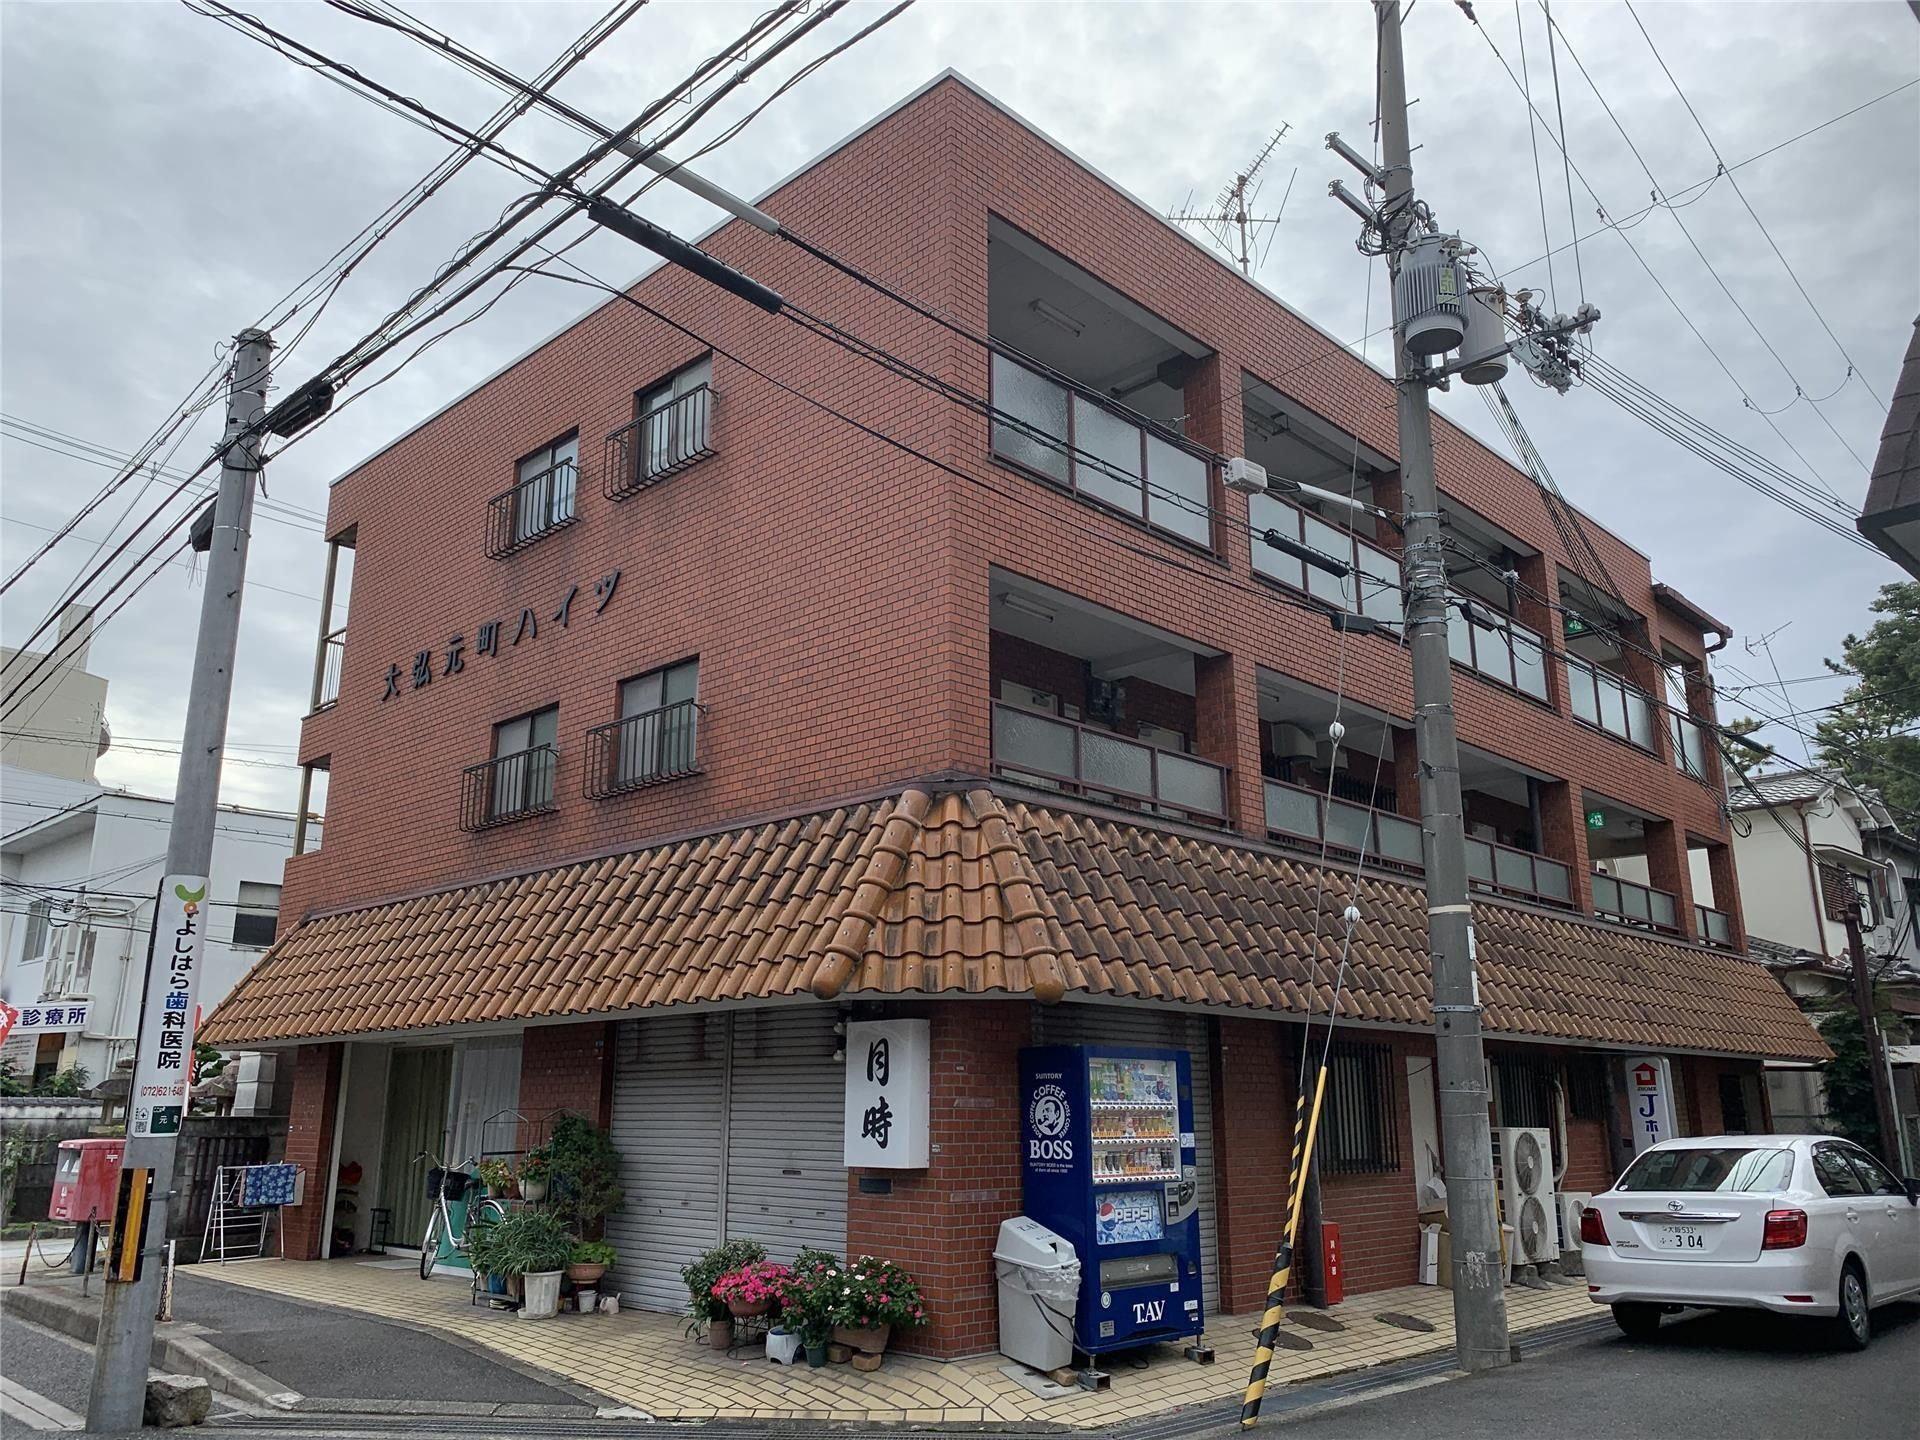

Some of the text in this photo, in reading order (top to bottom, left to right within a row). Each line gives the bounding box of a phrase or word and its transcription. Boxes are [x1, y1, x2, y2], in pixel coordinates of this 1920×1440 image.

[379, 568, 623, 702] 大弘元町ハイツ
[157, 919, 197, 1069] よしはら歯科医院
[14, 1007, 87, 1026] 診療所
[1033, 1084, 1066, 1100] COFFEE
[1029, 1140, 1073, 1160] BOSS
[1115, 1207, 1154, 1221] PEPSI
